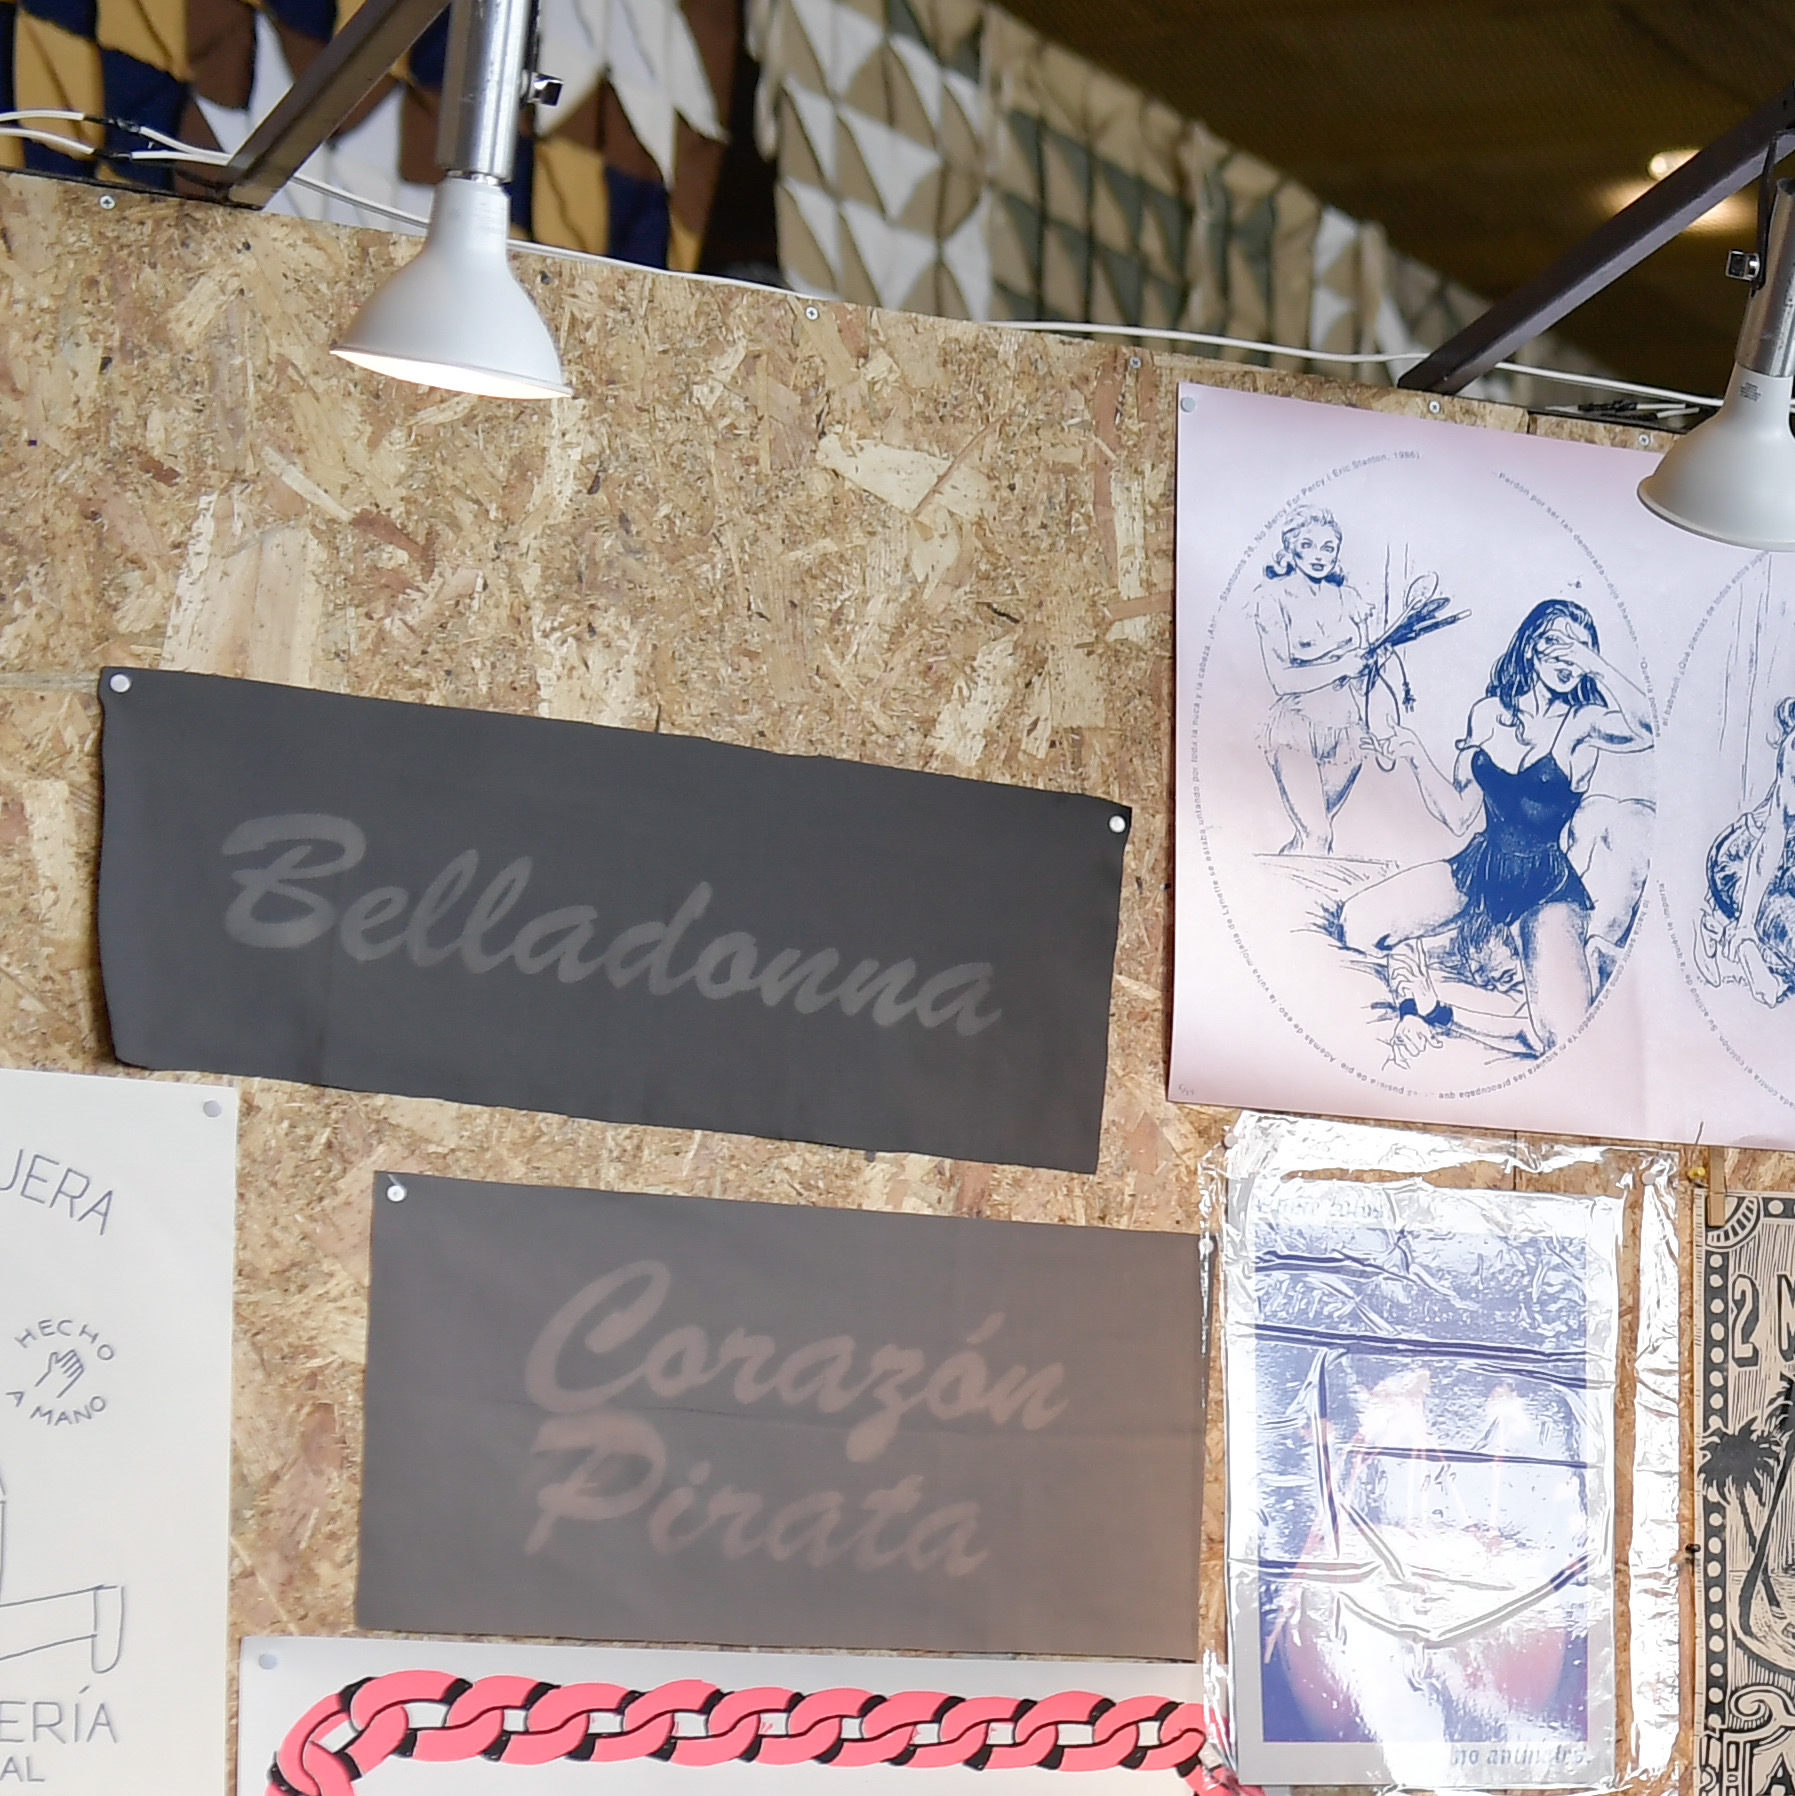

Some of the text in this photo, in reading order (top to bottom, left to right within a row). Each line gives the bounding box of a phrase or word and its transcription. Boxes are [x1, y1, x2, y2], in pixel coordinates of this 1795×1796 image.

[1284, 492, 1302, 508] For
[1299, 475, 1327, 498] Percy
[1252, 527, 1267, 543] No
[1262, 504, 1289, 532] Mercy
[1191, 701, 1200, 725] nuca
[219, 812, 1005, 1037] Belladonna
[1229, 931, 1255, 969] mojada
[1731, 1273, 1760, 1368] 2
[14, 1318, 116, 1363] HECHO
[524, 1259, 1069, 1463] Corazón
[30, 1396, 107, 1427] MANO
[524, 1407, 988, 1578] Pirata
